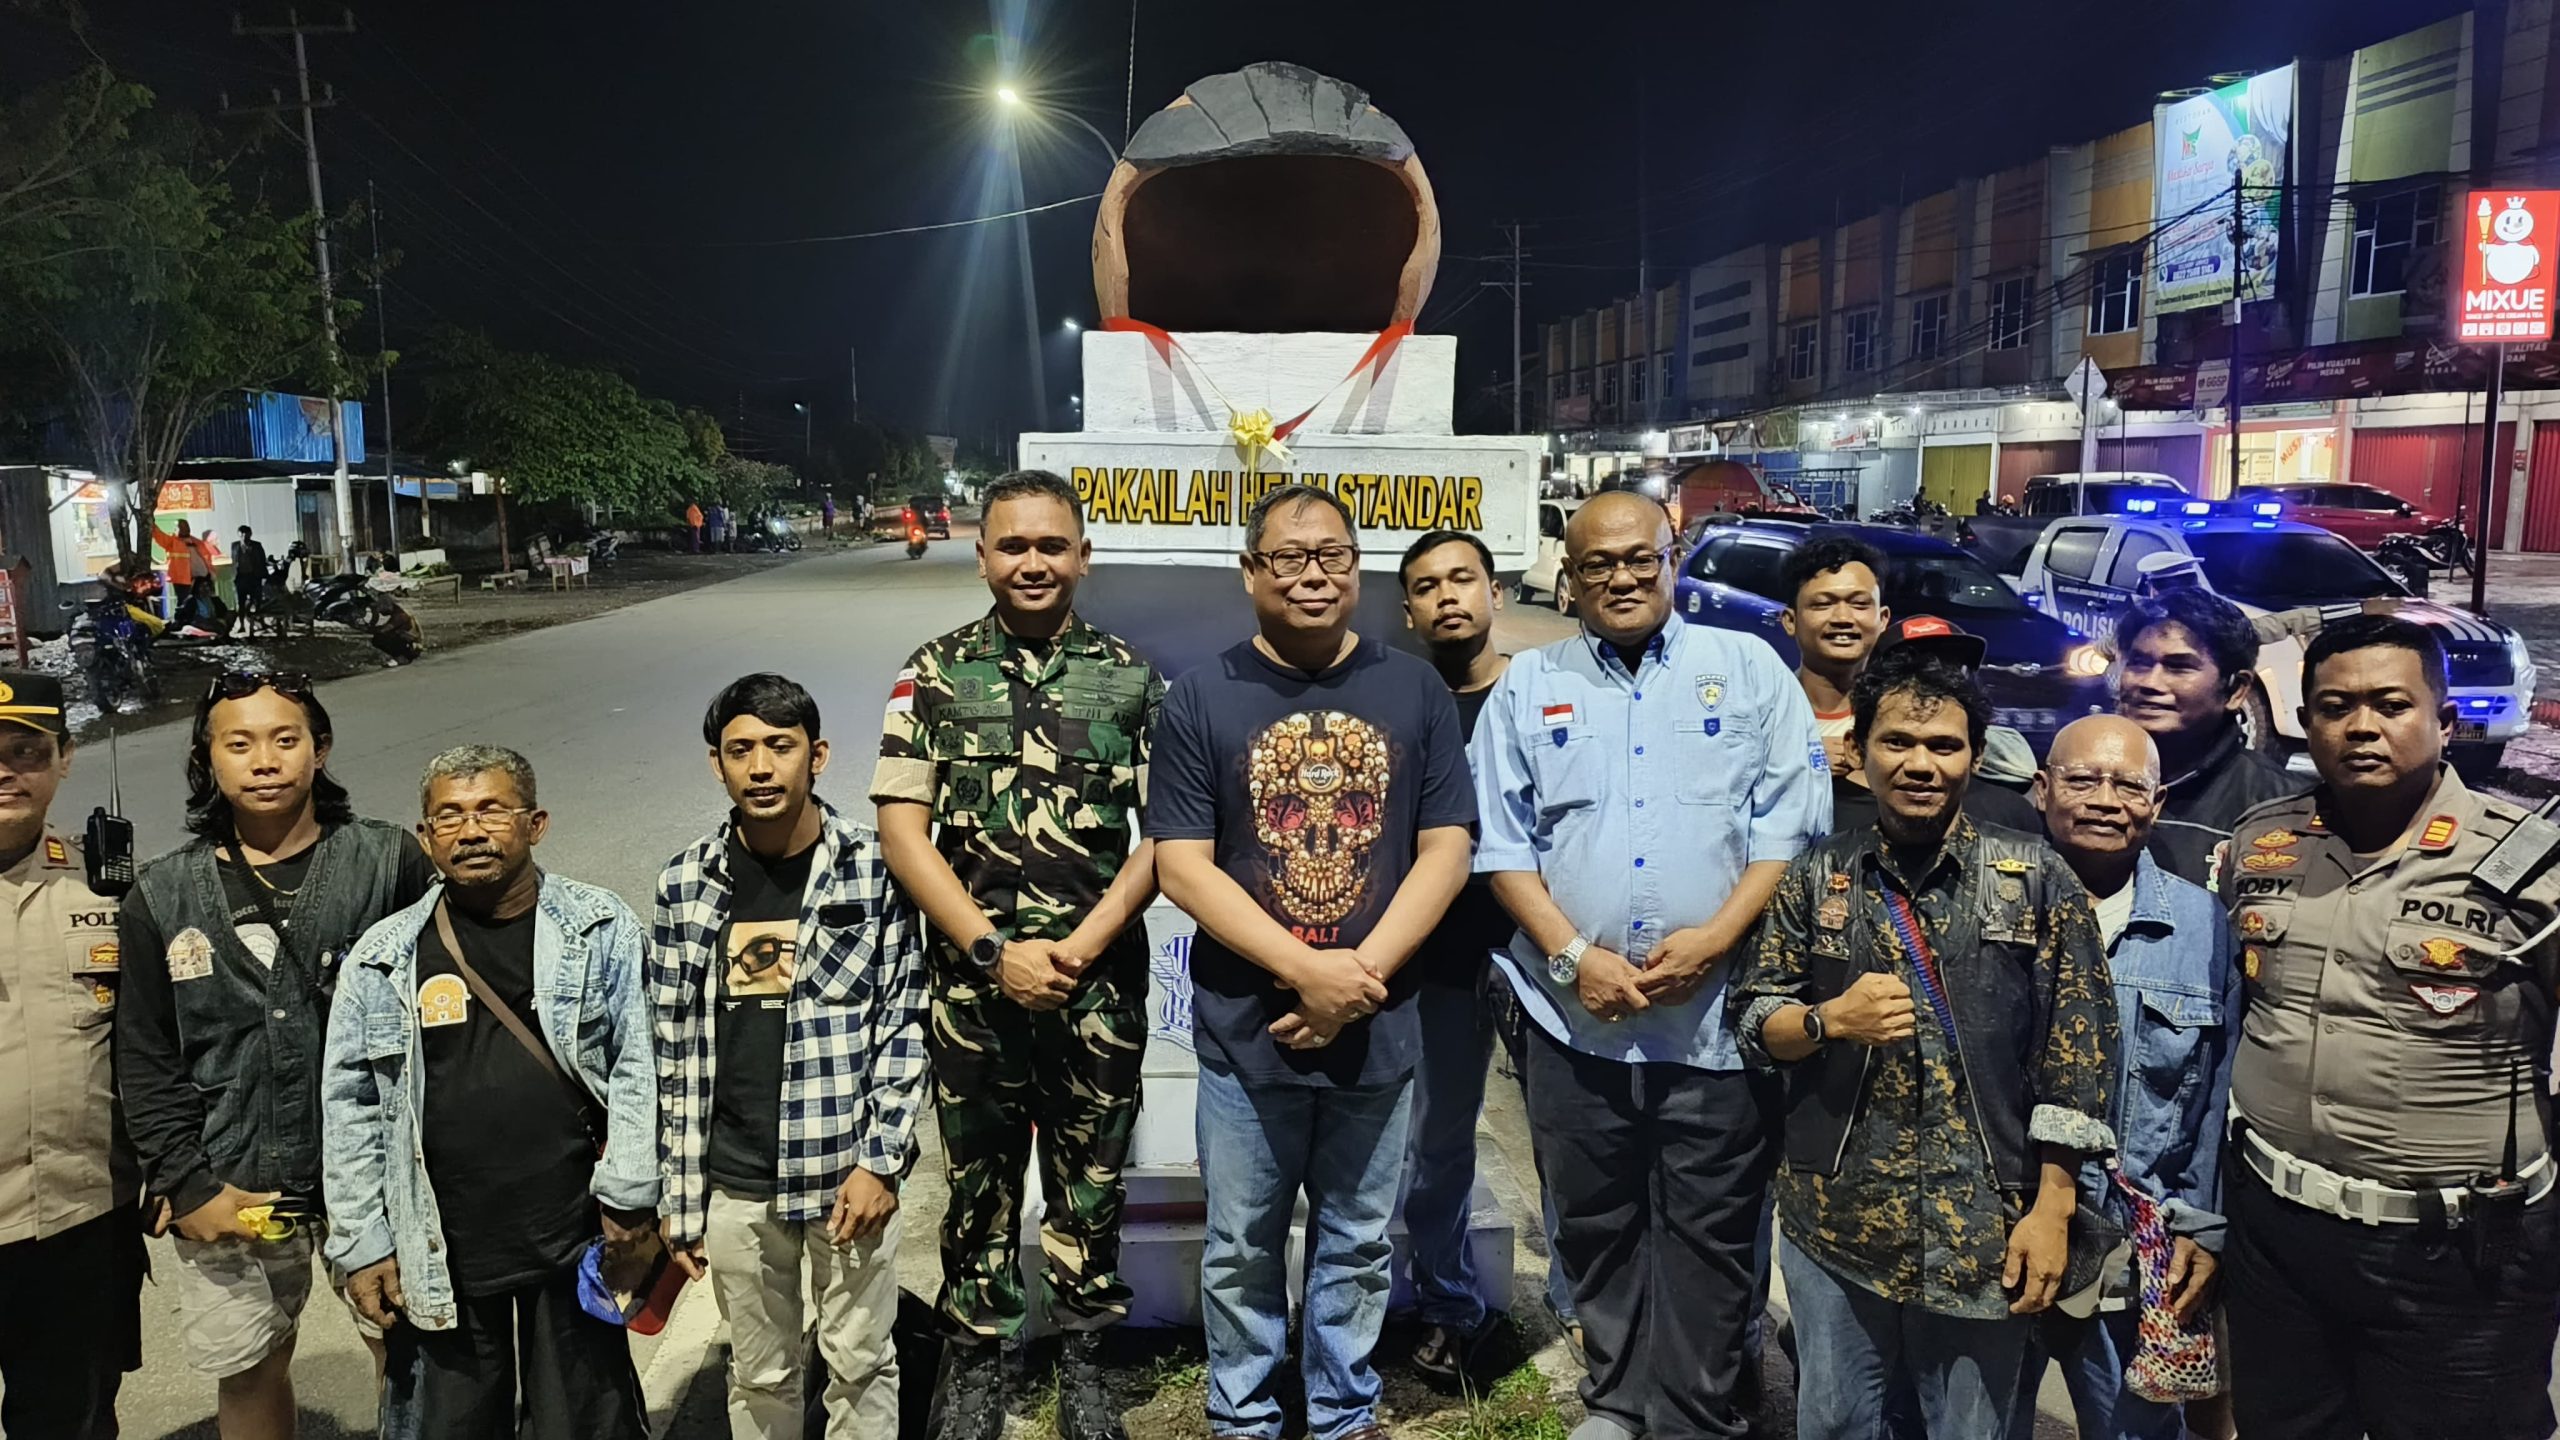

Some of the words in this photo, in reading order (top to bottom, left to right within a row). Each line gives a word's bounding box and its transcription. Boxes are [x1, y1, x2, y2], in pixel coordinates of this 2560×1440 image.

[2466, 288, 2545, 312] MIXUE
[2510, 342, 2548, 353] ALITAS
[2506, 354, 2526, 363] RAH
[1072, 466, 1233, 526] PAKAILAH
[1337, 472, 1483, 531] STANDAR
[1301, 768, 1320, 779] Hard
[1321, 767, 1340, 780] Rock
[69, 912, 120, 928] POL
[2401, 899, 2497, 934] POLRI
[1291, 925, 1340, 943] BALI
